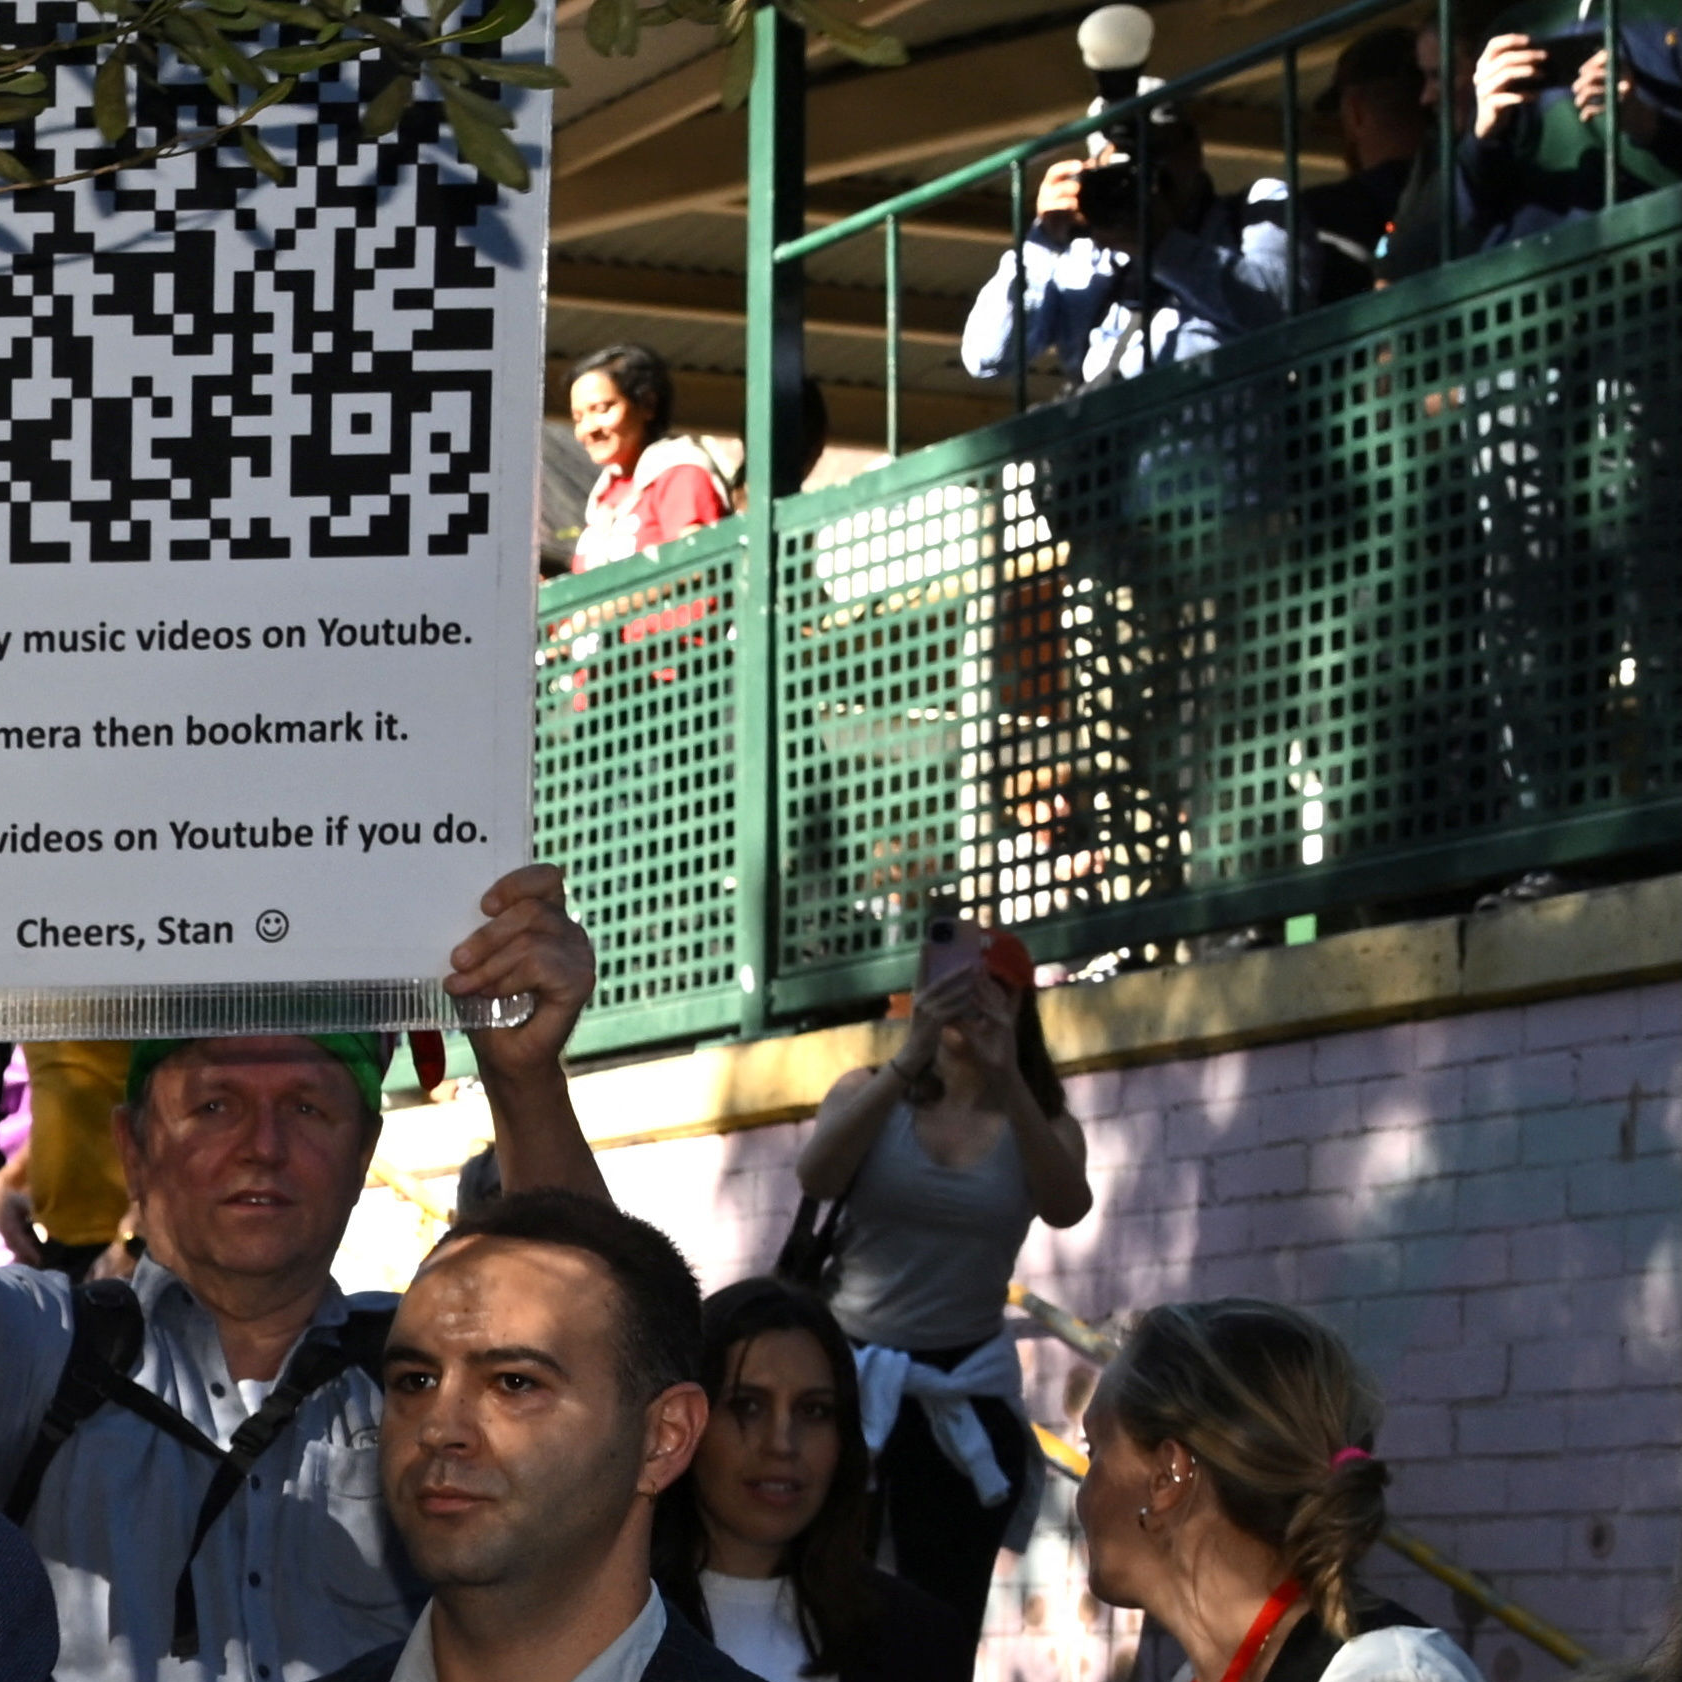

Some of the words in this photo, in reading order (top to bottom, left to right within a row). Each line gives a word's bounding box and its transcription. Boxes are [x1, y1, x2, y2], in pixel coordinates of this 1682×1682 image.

[23, 621, 126, 654] music
[135, 619, 252, 652] videos
[262, 625, 306, 649] on
[317, 613, 472, 648] Youtube.
[92, 716, 174, 748] then
[186, 710, 364, 746] bookmark
[375, 710, 408, 742] it.
[113, 828, 158, 852] on
[168, 816, 314, 850] Youtube
[325, 814, 350, 847] if
[357, 822, 421, 854] you
[432, 812, 488, 844] do.
[16, 916, 146, 952] Cheers,
[157, 915, 234, 946] Stan
